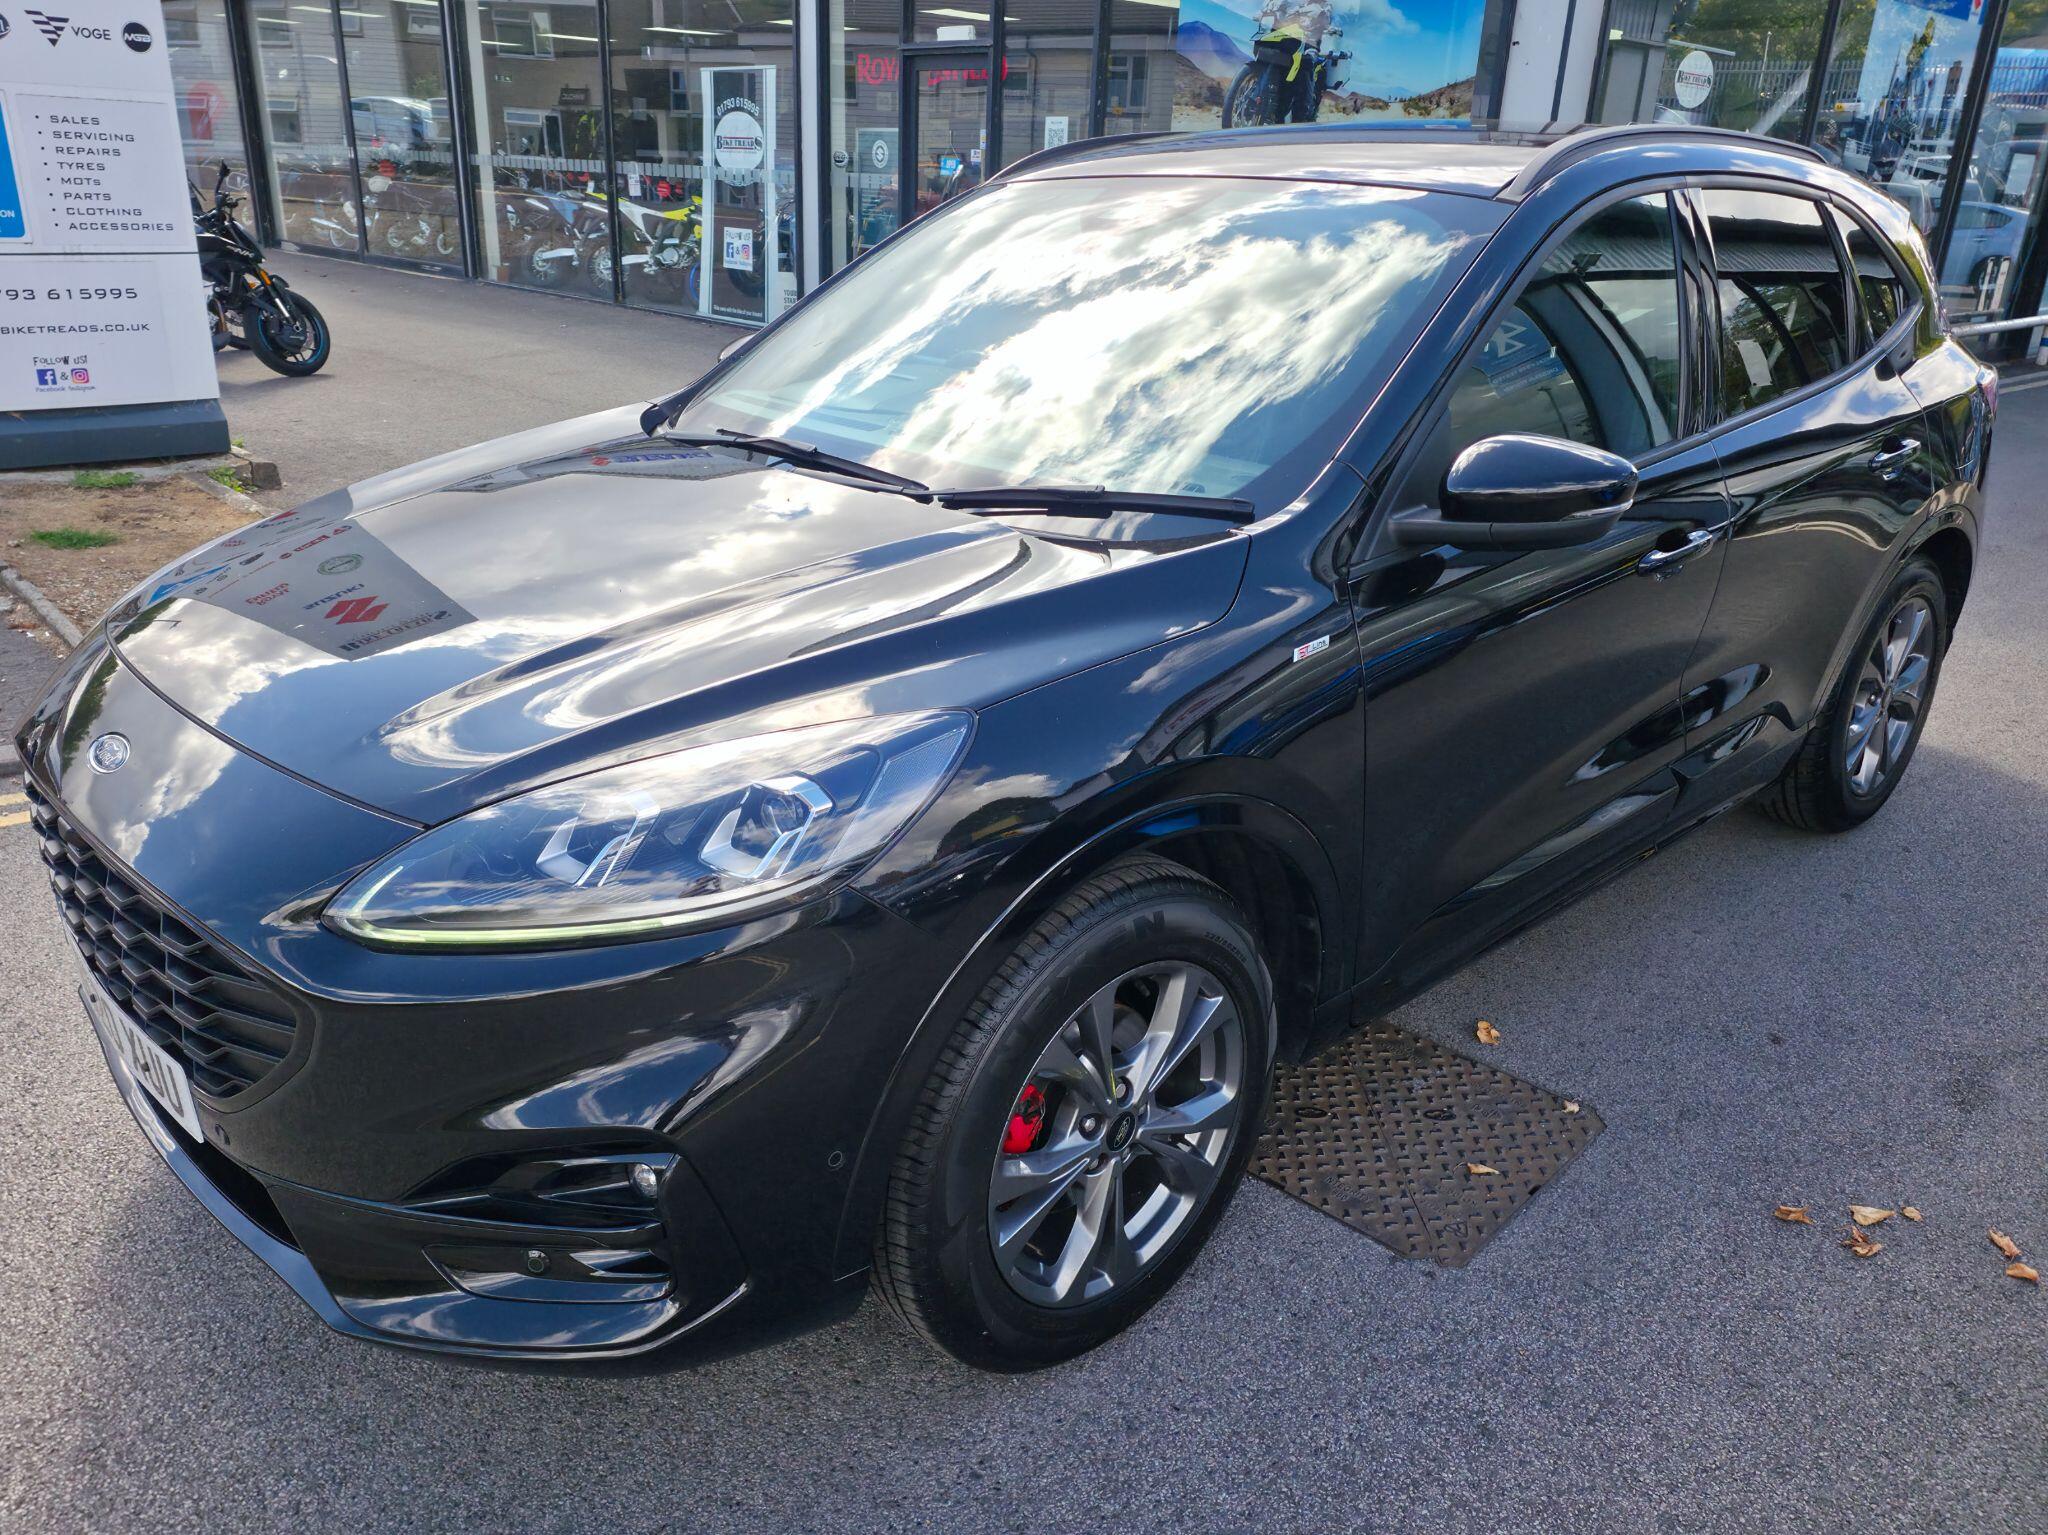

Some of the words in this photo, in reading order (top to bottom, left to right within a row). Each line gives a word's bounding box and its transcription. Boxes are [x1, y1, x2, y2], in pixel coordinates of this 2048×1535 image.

[71, 26, 112, 41] VOGE
[856, 53, 899, 85] ROY
[736, 97, 761, 117] 615995
[50, 115, 100, 126] SALES
[53, 131, 135, 142] SERVICING
[56, 146, 121, 157] REPAIRS
[57, 161, 106, 171] TYRES
[63, 192, 112, 201] PARTS
[66, 207, 143, 216] CLOTHING
[69, 222, 174, 231] ACCESSORIES
[0, 289, 36, 301] 93
[47, 288, 138, 300] 615995
[33, 355, 70, 366] FOLLOW
[60, 372, 70, 381] &
[36, 385, 66, 393] Facebook
